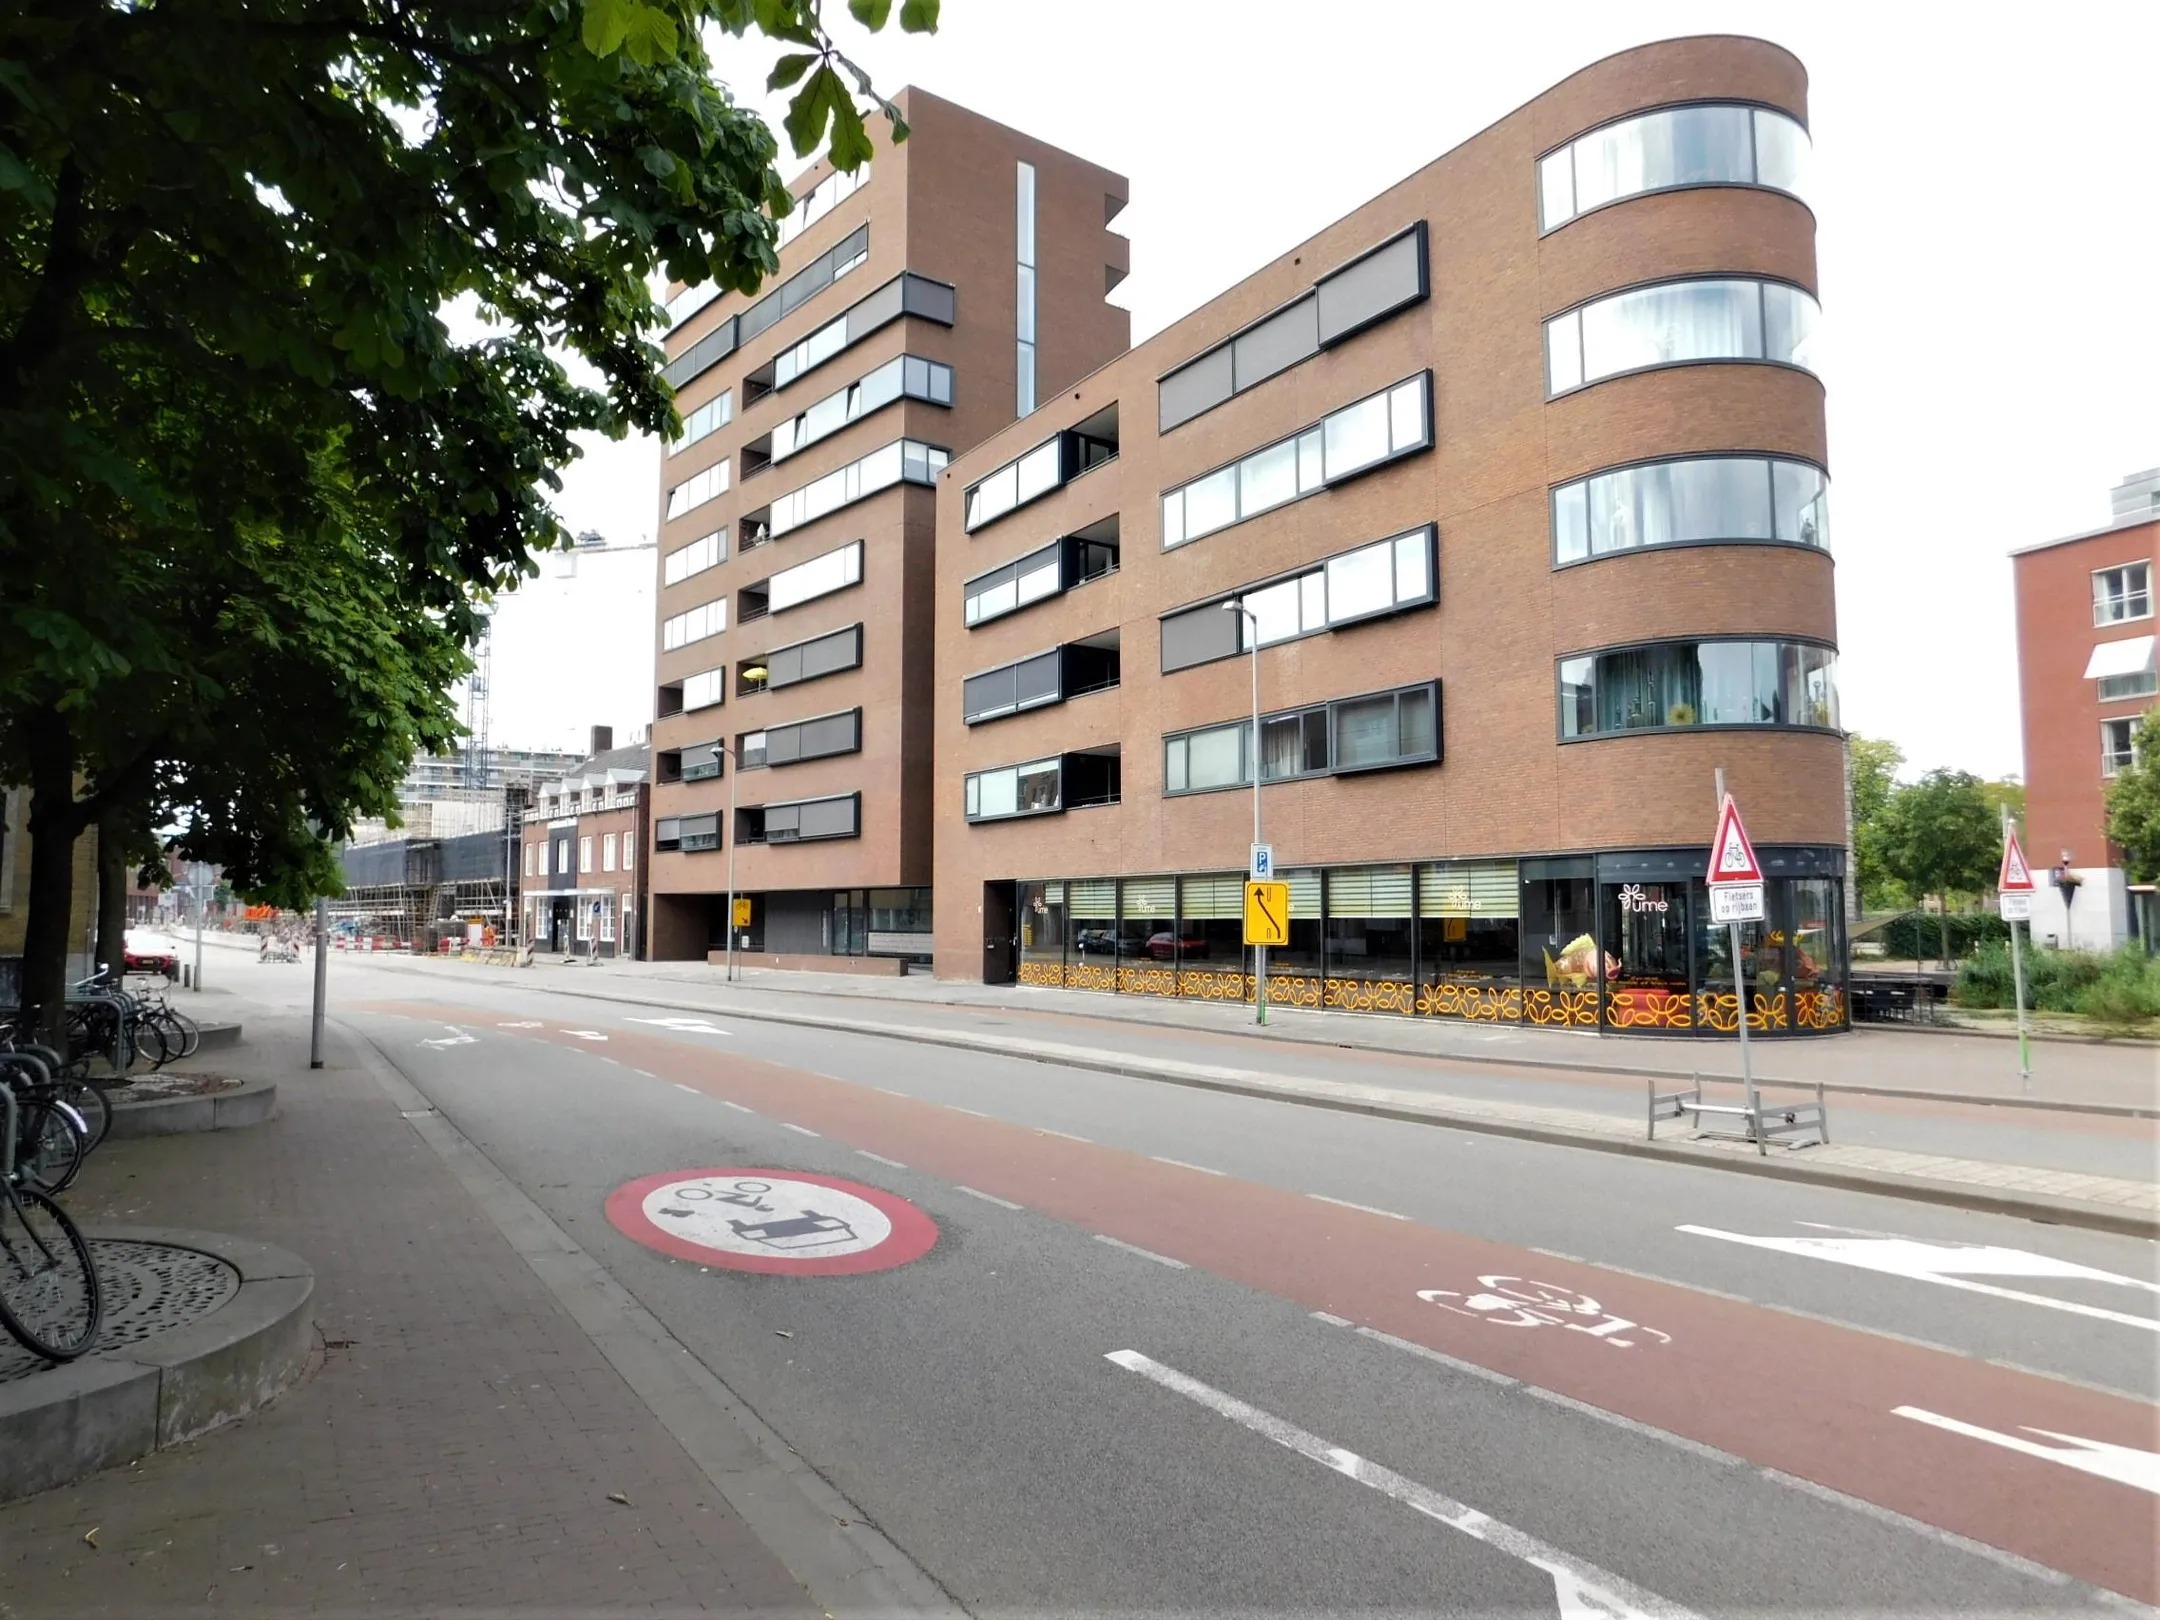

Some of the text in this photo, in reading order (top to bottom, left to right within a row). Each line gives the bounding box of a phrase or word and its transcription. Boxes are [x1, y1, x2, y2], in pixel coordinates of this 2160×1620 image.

[1724, 891, 1754, 901] Fietsers
[1632, 900, 1668, 912] ume
[1732, 902, 1757, 914] rijbaan
